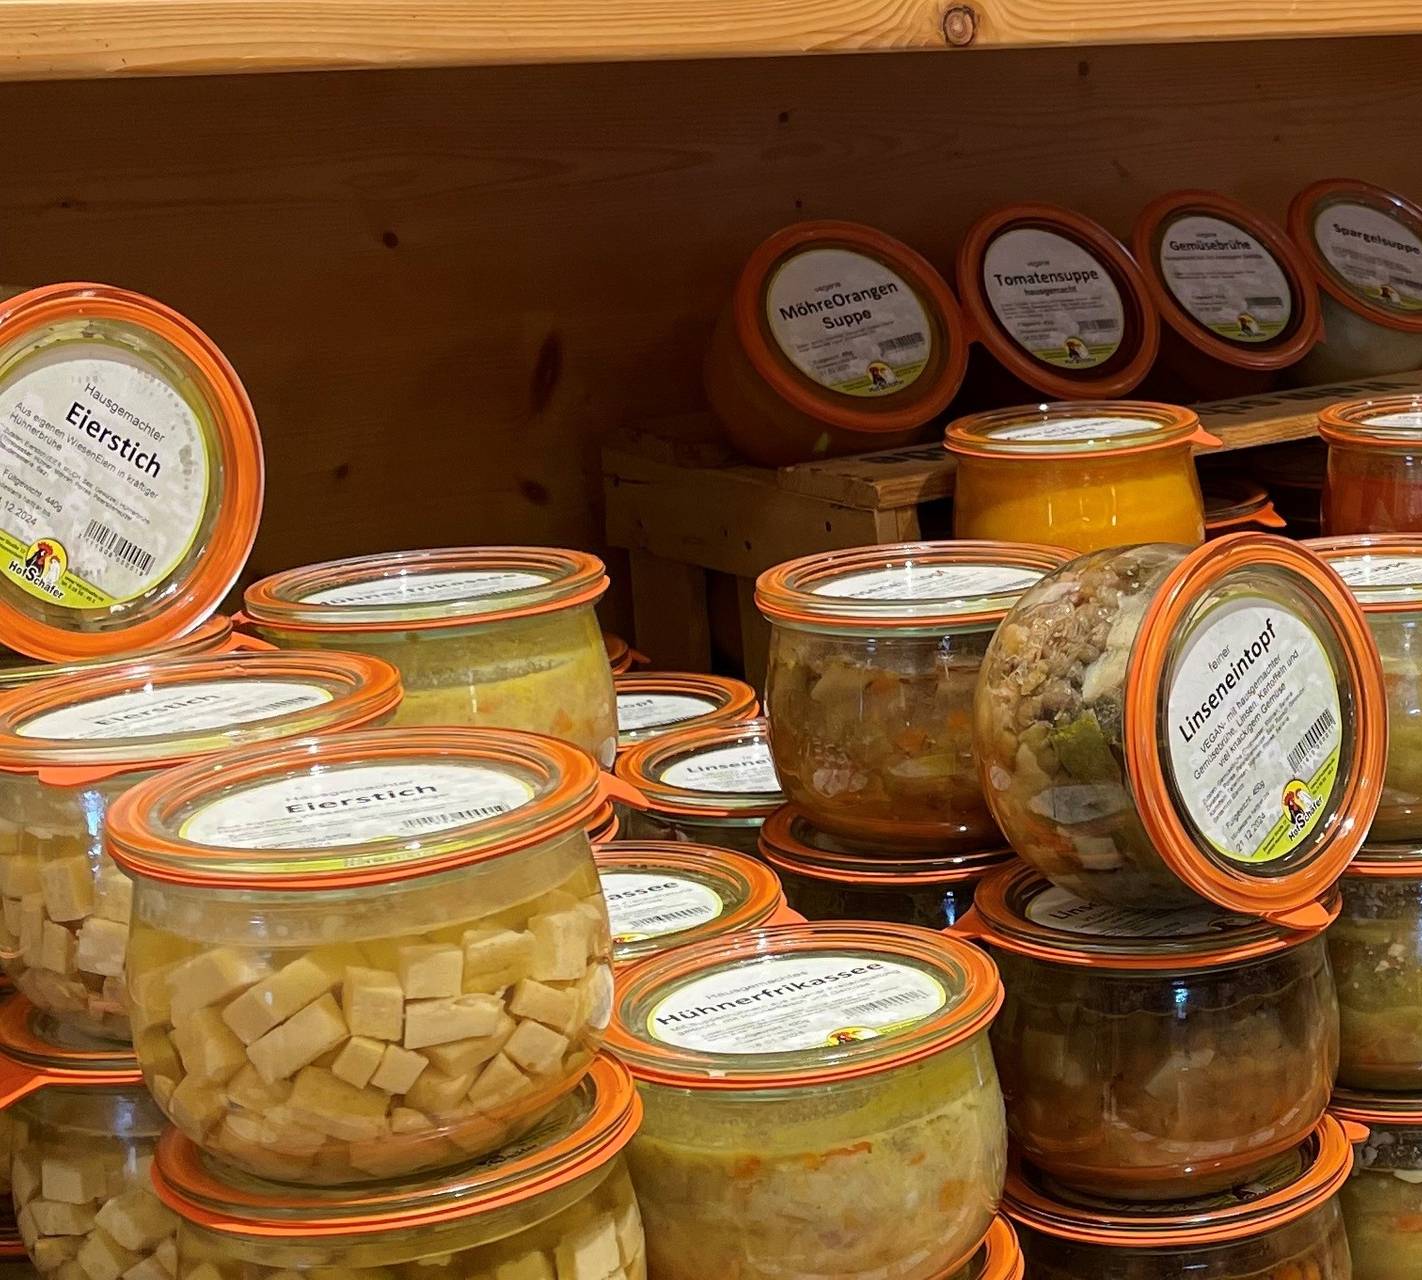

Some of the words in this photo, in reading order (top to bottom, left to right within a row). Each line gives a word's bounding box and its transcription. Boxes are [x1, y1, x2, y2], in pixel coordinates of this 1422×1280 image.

[1332, 223, 1420, 255] Spargelsuppe
[993, 268, 1099, 288] Tomatensuppe
[779, 281, 899, 322] MöhreOrangen
[822, 308, 872, 331] Suppe
[84, 382, 165, 443] Hausgemachter
[15, 401, 32, 417] Aus
[34, 413, 66, 440] eigenen
[117, 467, 126, 479] in
[65, 401, 161, 478] Eierstich
[1179, 618, 1277, 743] Linseneintopf
[1236, 654, 1281, 710] hausgemachter
[1257, 664, 1288, 700] Kartoffeln
[1286, 650, 1299, 667] und
[93, 692, 222, 728] Eierstich
[1260, 682, 1287, 715] Gemüse
[686, 757, 772, 775] Linsene
[285, 784, 437, 815] Eierstich
[656, 961, 885, 1026] Hühnerfrikassee
